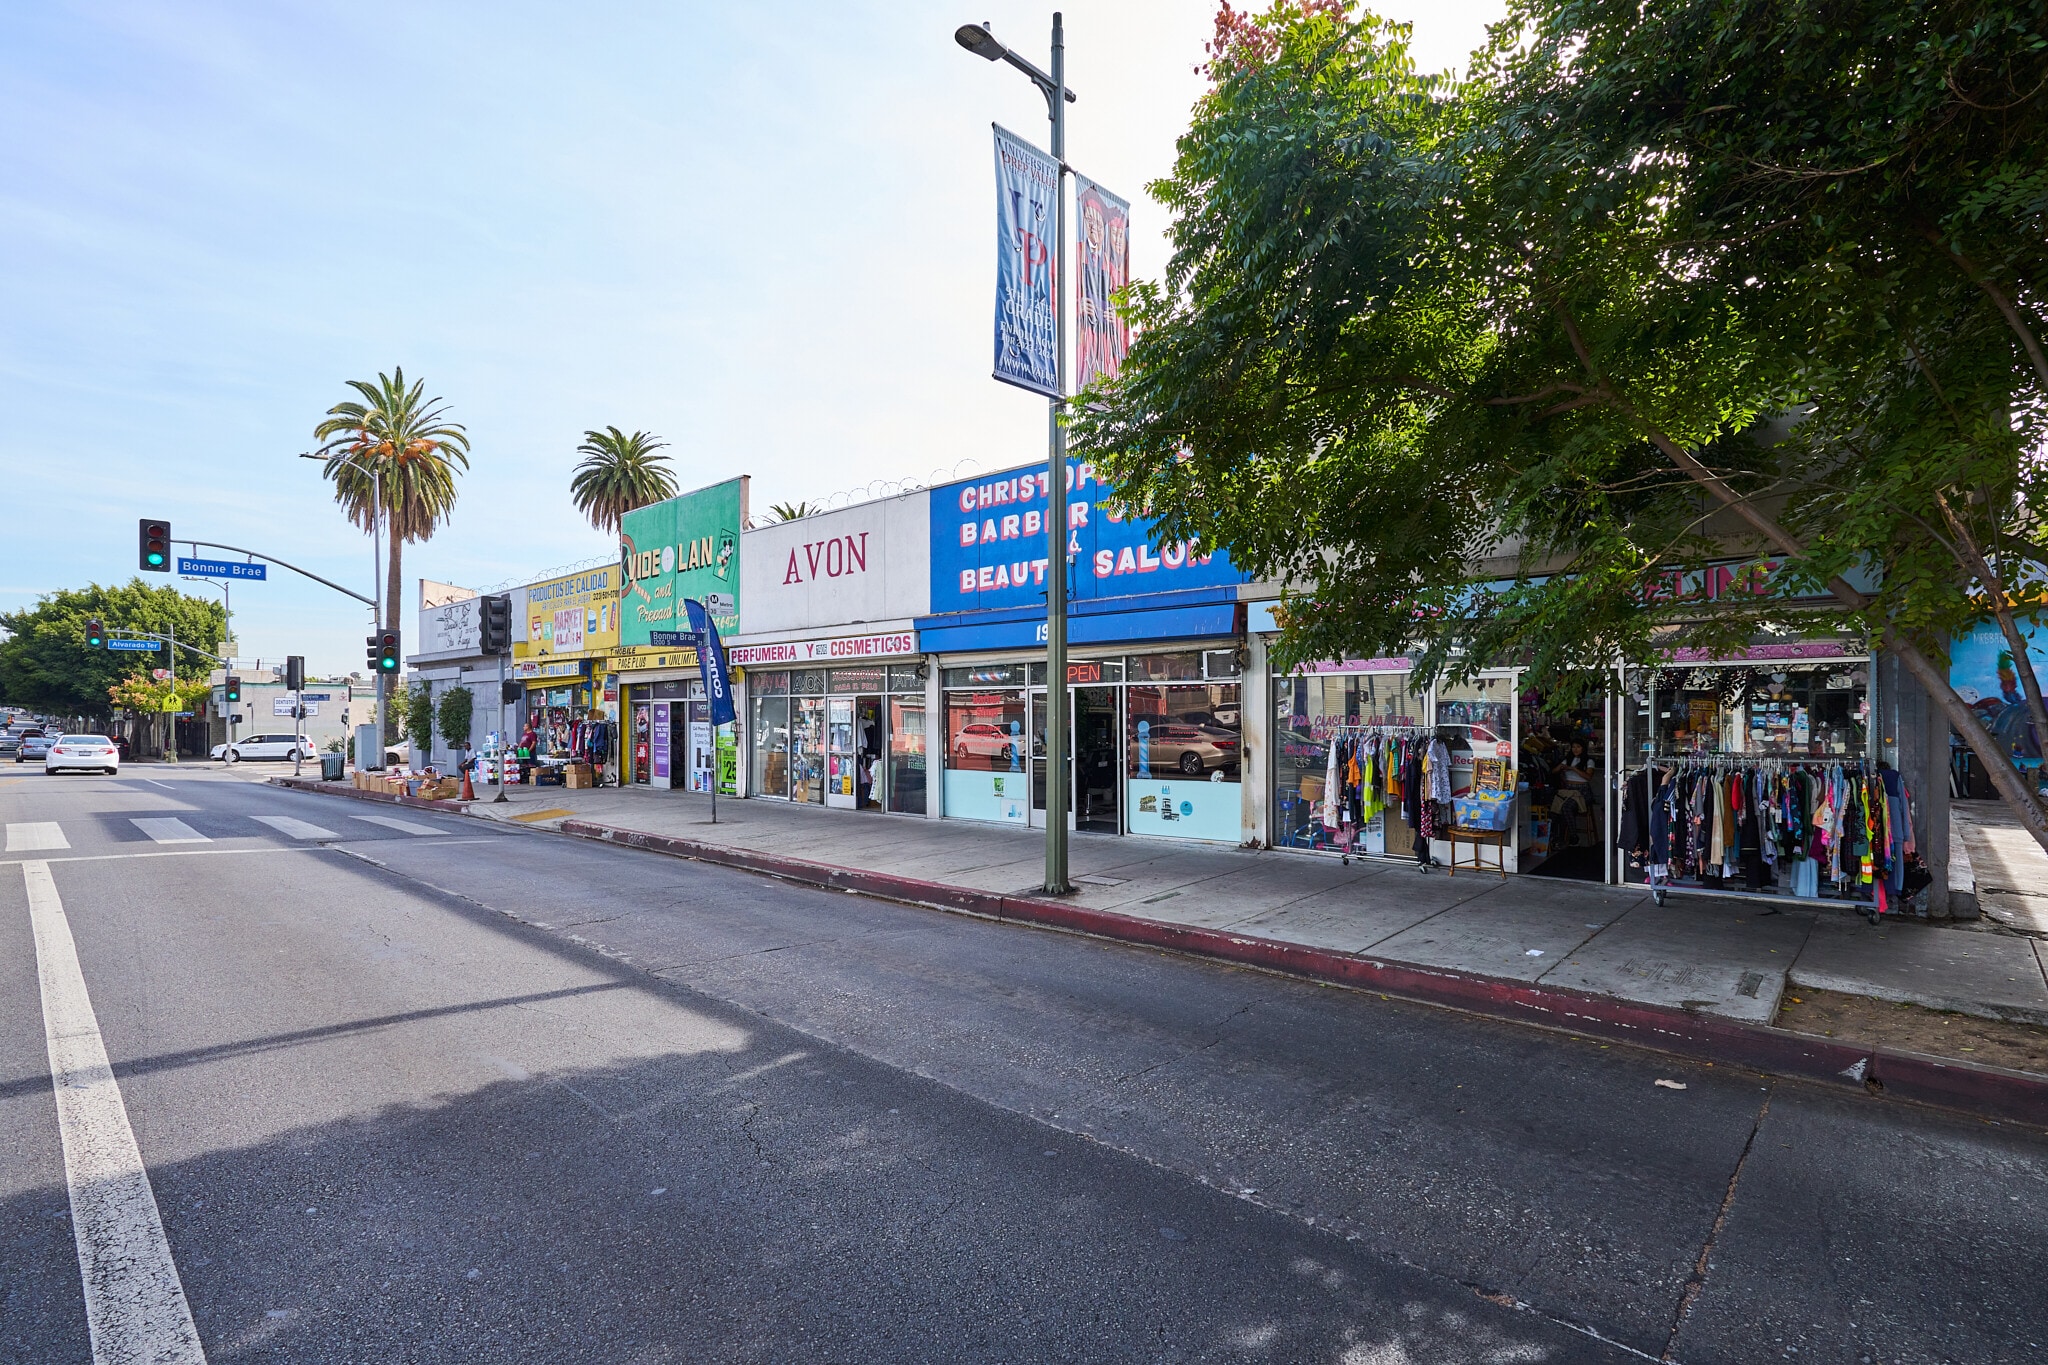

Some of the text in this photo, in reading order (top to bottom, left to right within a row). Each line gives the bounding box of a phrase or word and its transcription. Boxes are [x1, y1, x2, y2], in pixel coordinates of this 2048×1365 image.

[960, 502, 1089, 547] BARBR
[1068, 530, 1083, 554] &
[782, 531, 869, 586] AVON
[183, 561, 262, 577] Bonnie Brae
[960, 557, 1070, 594] BEAUT
[528, 571, 608, 603] PRODUCTOS DE CALIDAD
[654, 579, 673, 599] and
[554, 607, 584, 631] MARKET
[636, 599, 674, 624] Prepaid
[112, 640, 159, 650] Alvarado Ter
[653, 631, 696, 641] Bonnie Brae
[610, 646, 637, 656] T-MOBILE
[731, 645, 797, 665] PERFUMERIA
[806, 643, 814, 658] Y
[830, 635, 911, 657] COSMETICOS
[522, 663, 536, 672] ATM
[632, 656, 647, 668] PLUS
[793, 674, 825, 692] AVON
[1067, 664, 1101, 683] PEN
